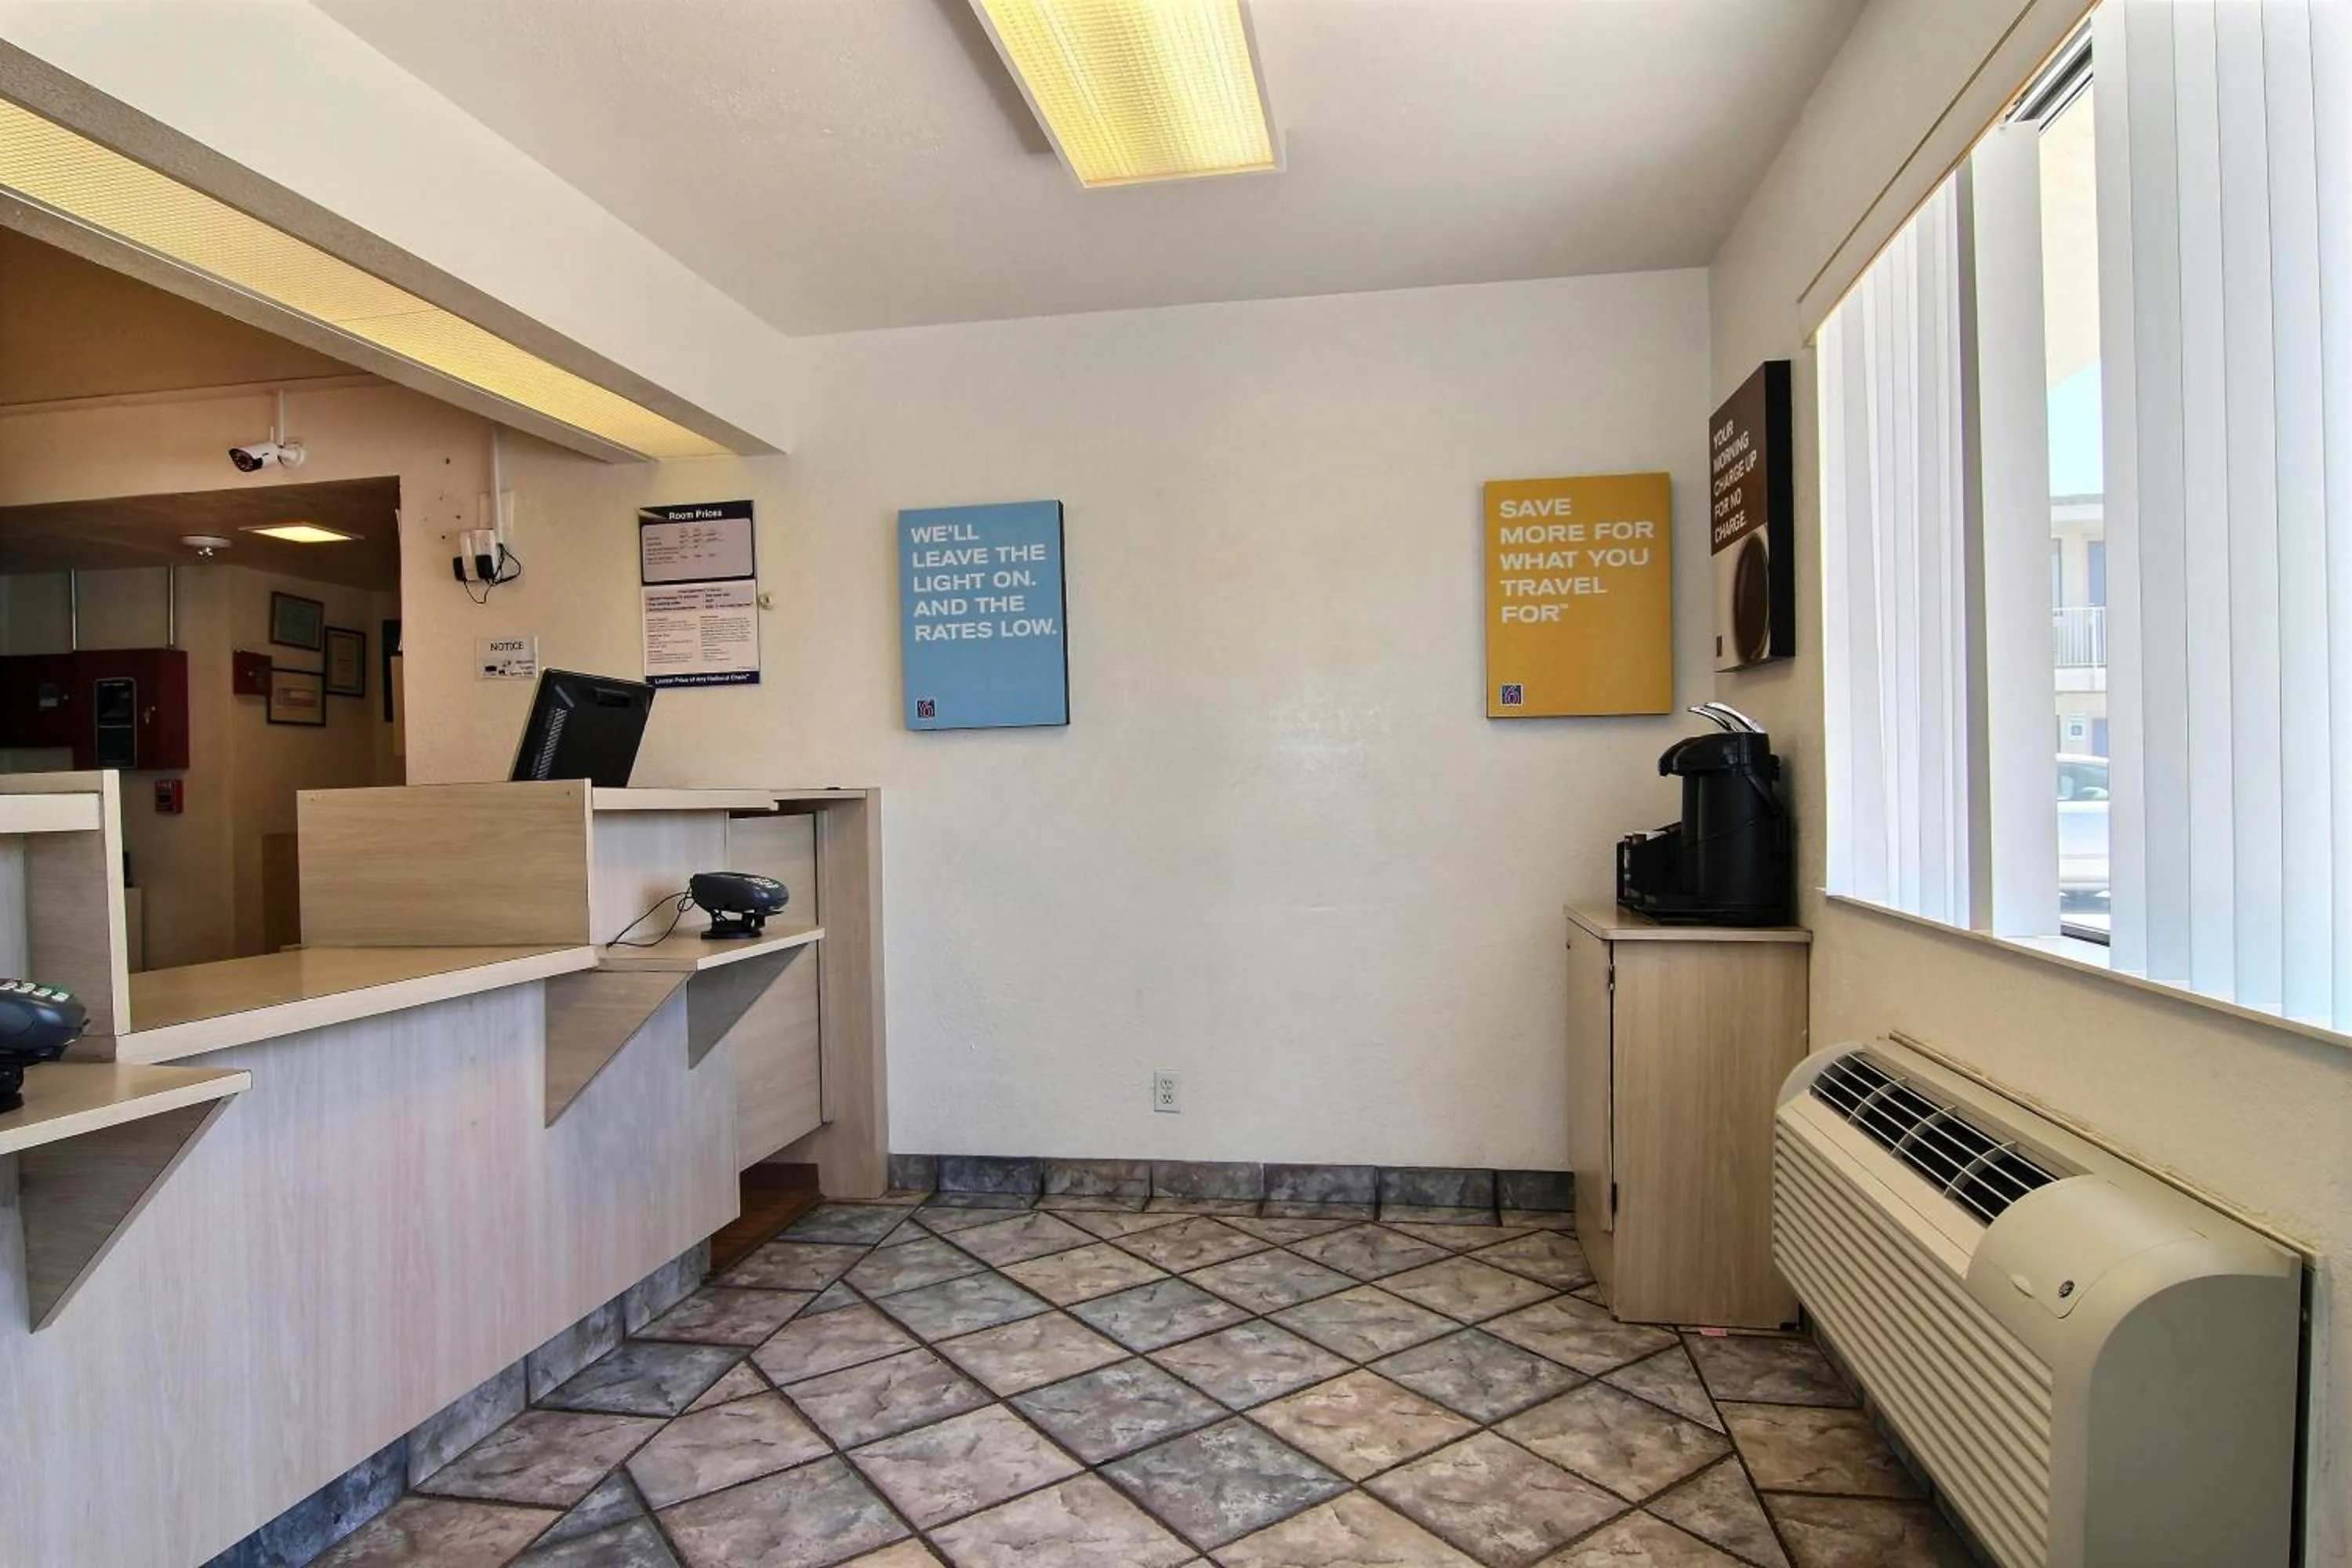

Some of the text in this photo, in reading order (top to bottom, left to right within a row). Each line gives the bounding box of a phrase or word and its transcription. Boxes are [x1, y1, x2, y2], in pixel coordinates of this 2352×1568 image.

[1713, 419, 1733, 451] YOUR
[1713, 430, 1749, 474] MORNING
[1713, 449, 1757, 495] CHARGE UP
[669, 510, 722, 520] Room Prices
[1499, 498, 1572, 519] SAVE
[1715, 487, 1742, 521] FOR NO
[911, 524, 979, 543] WE'LL
[1500, 521, 1654, 545] MORE FOR
[913, 543, 1047, 568] LEAVE THE
[1499, 547, 1650, 571] WHAT YOU
[913, 570, 1037, 593] LIGHT ON.
[1500, 576, 1607, 597] TRAVEL
[913, 595, 1025, 617] AND THE
[915, 618, 1057, 641] RATES LOW.
[490, 641, 524, 652] NOTICE
